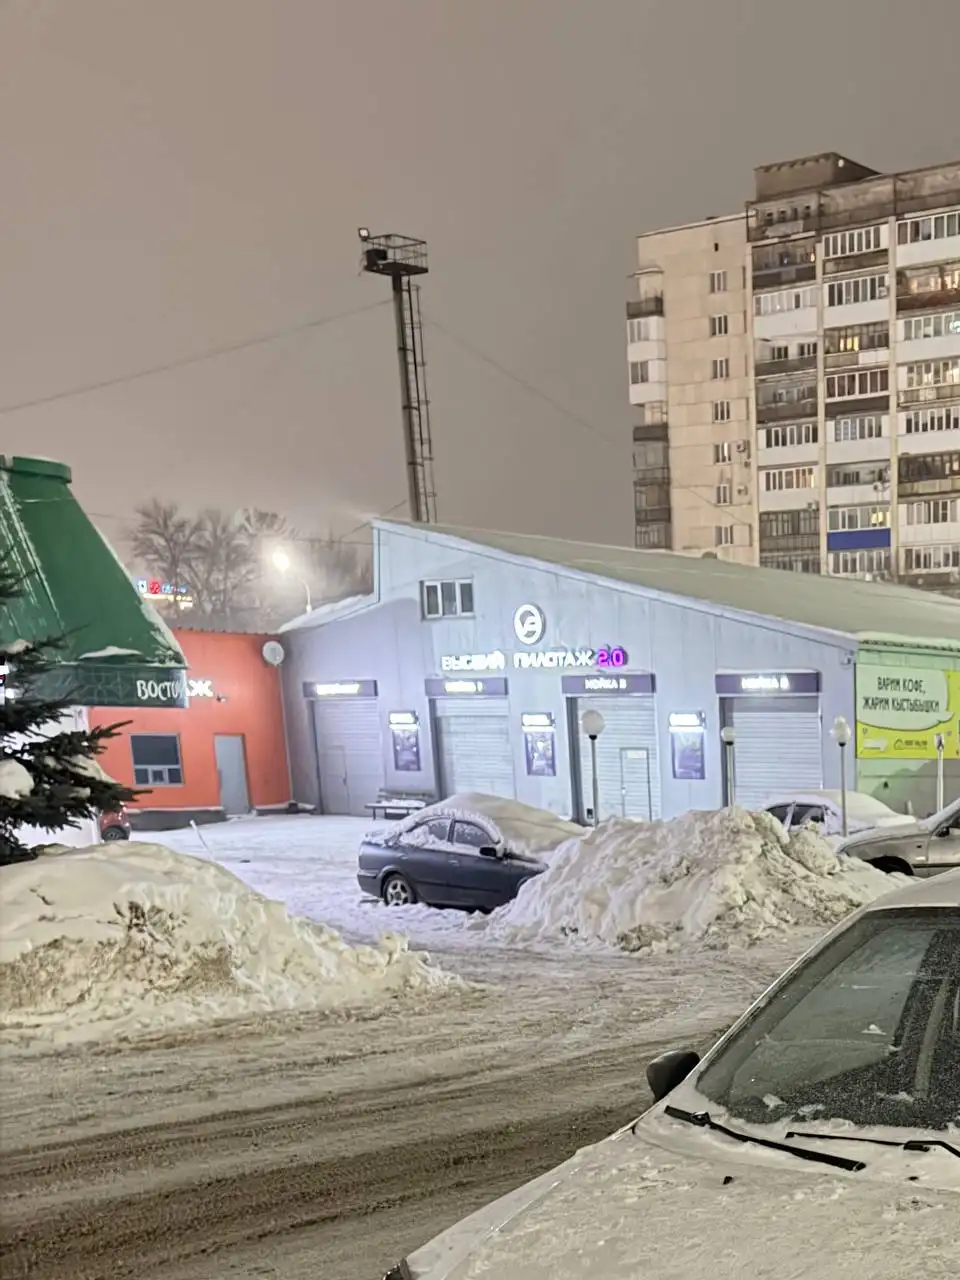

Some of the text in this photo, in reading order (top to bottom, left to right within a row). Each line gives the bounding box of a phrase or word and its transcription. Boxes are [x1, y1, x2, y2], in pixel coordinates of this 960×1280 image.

[441, 650, 505, 671] ВЫСШИЙ
[513, 651, 594, 669] ПИЛОТАЖ
[877, 676, 926, 695] ВАРИМ КОФЕ,
[862, 696, 890, 711] ЖАРИМ
